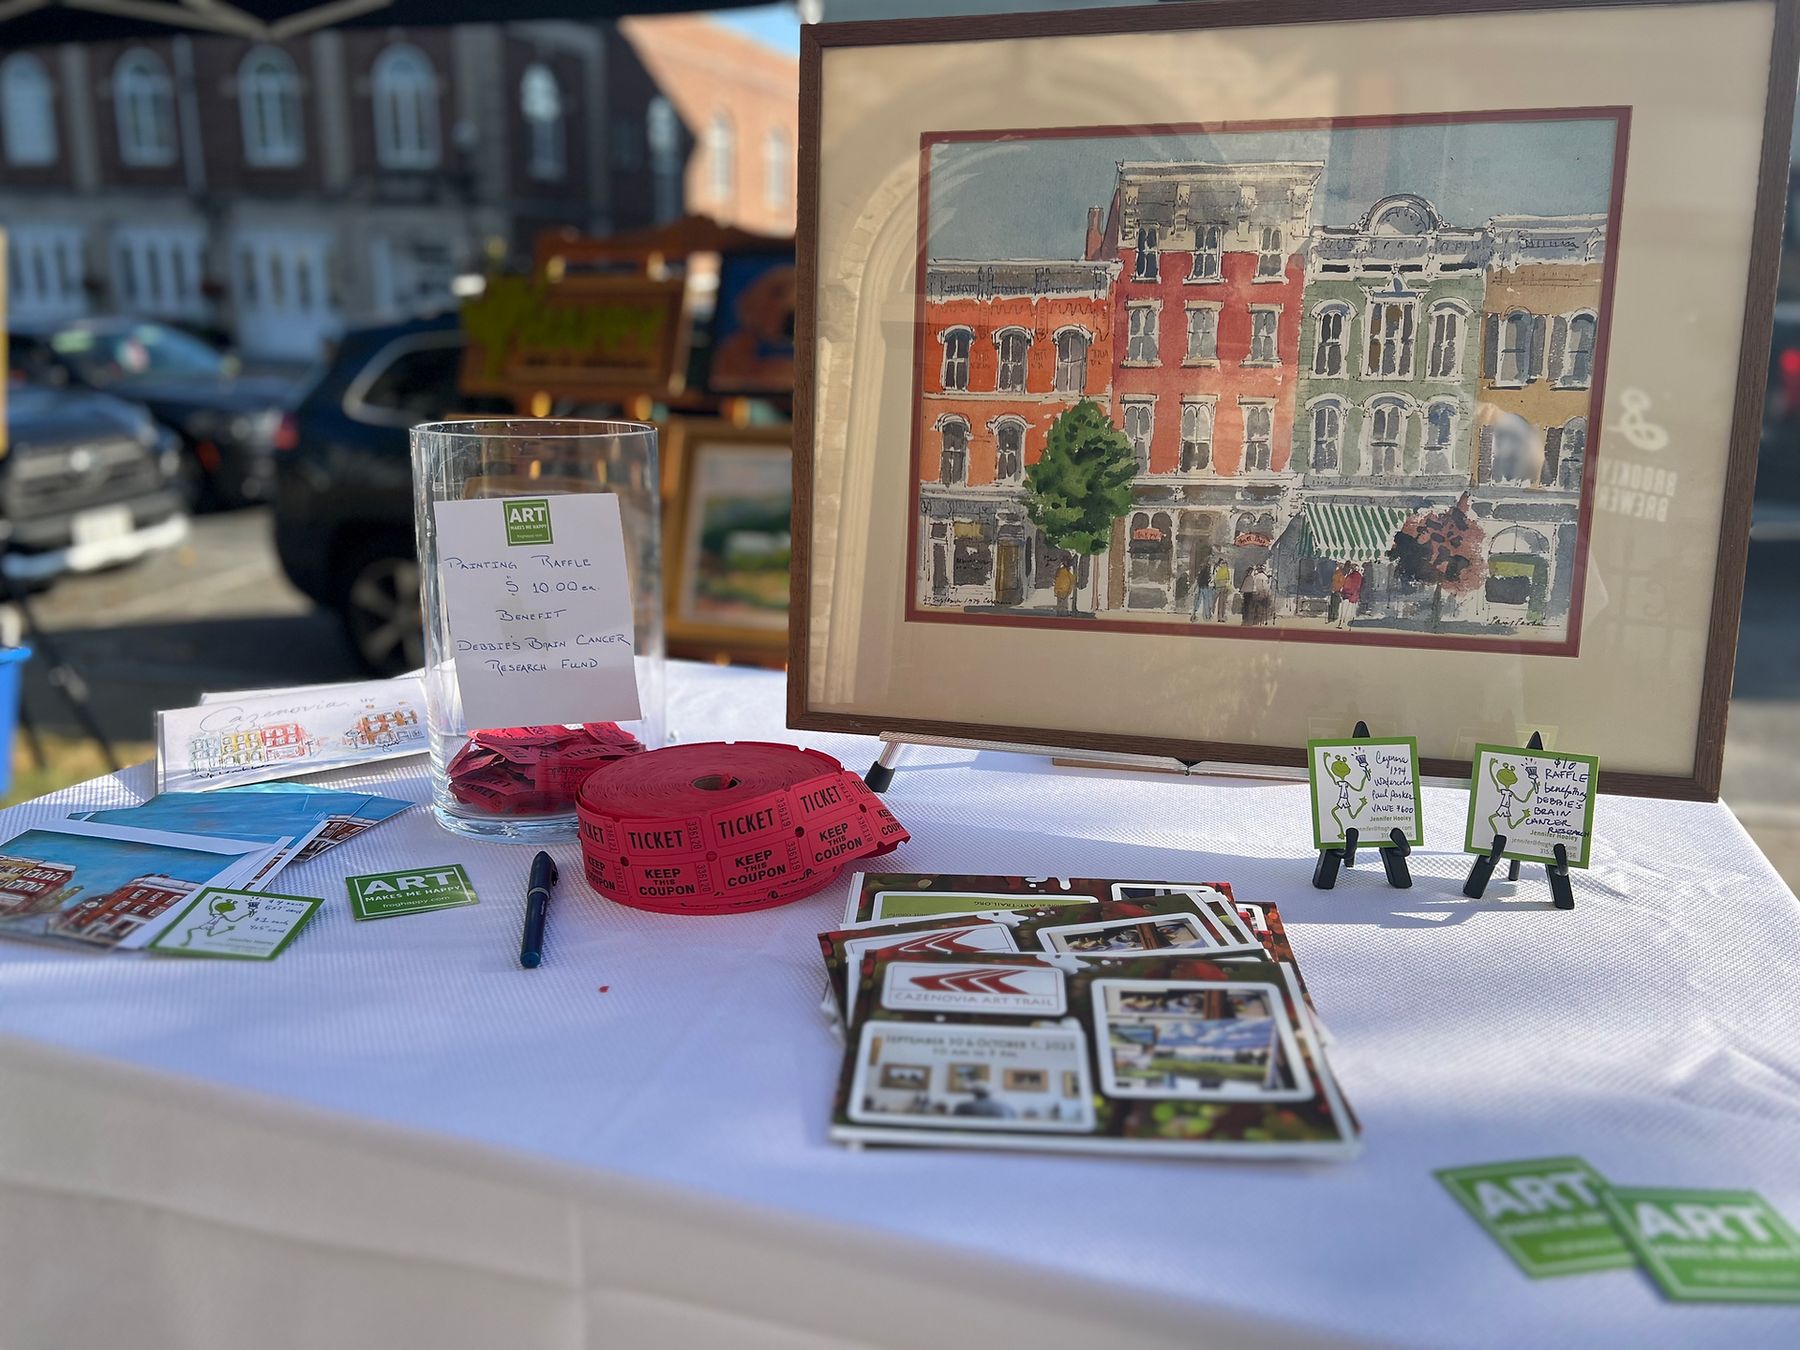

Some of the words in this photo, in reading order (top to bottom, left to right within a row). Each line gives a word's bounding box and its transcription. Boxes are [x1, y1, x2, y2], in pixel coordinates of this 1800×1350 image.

[509, 507, 546, 523] ART
[445, 557, 518, 570] PAINTING
[531, 555, 591, 568] RAFFLE
[495, 609, 567, 621] BENEFIT
[525, 637, 566, 651] BRAIN
[576, 634, 631, 646] CANCER
[485, 660, 547, 676] RESEARCH
[561, 658, 598, 669] FUND
[563, 746, 611, 760] TICKET
[1545, 769, 1590, 783] RAFFLE
[800, 785, 842, 813] TICKET
[776, 797, 792, 827] 336119
[1534, 807, 1571, 817] BRAIN
[717, 808, 774, 839] TICKET
[1525, 818, 1571, 828] CANCER
[628, 830, 683, 849] TICKET
[687, 821, 703, 850] 336120
[819, 822, 848, 842] KEEP
[827, 835, 847, 846] THIS
[787, 841, 801, 871] 336119
[814, 836, 863, 862] COUPON
[587, 854, 605, 872] KEEP
[734, 849, 773, 868] KEEP
[644, 868, 681, 879] KEEP
[727, 864, 787, 887] COUPON
[744, 862, 767, 873] THIS
[363, 871, 455, 895] ART
[639, 884, 696, 896] COUPON
[365, 893, 403, 902] MAKES
[425, 885, 460, 895] HAPPY
[382, 895, 451, 908] froghappy.com
[894, 992, 976, 1004] CAZENOVIA
[981, 996, 1010, 1005] ART
[1015, 998, 1053, 1007] TRAIL
[1472, 1168, 1601, 1219] ART
[1633, 1202, 1772, 1244] ART
